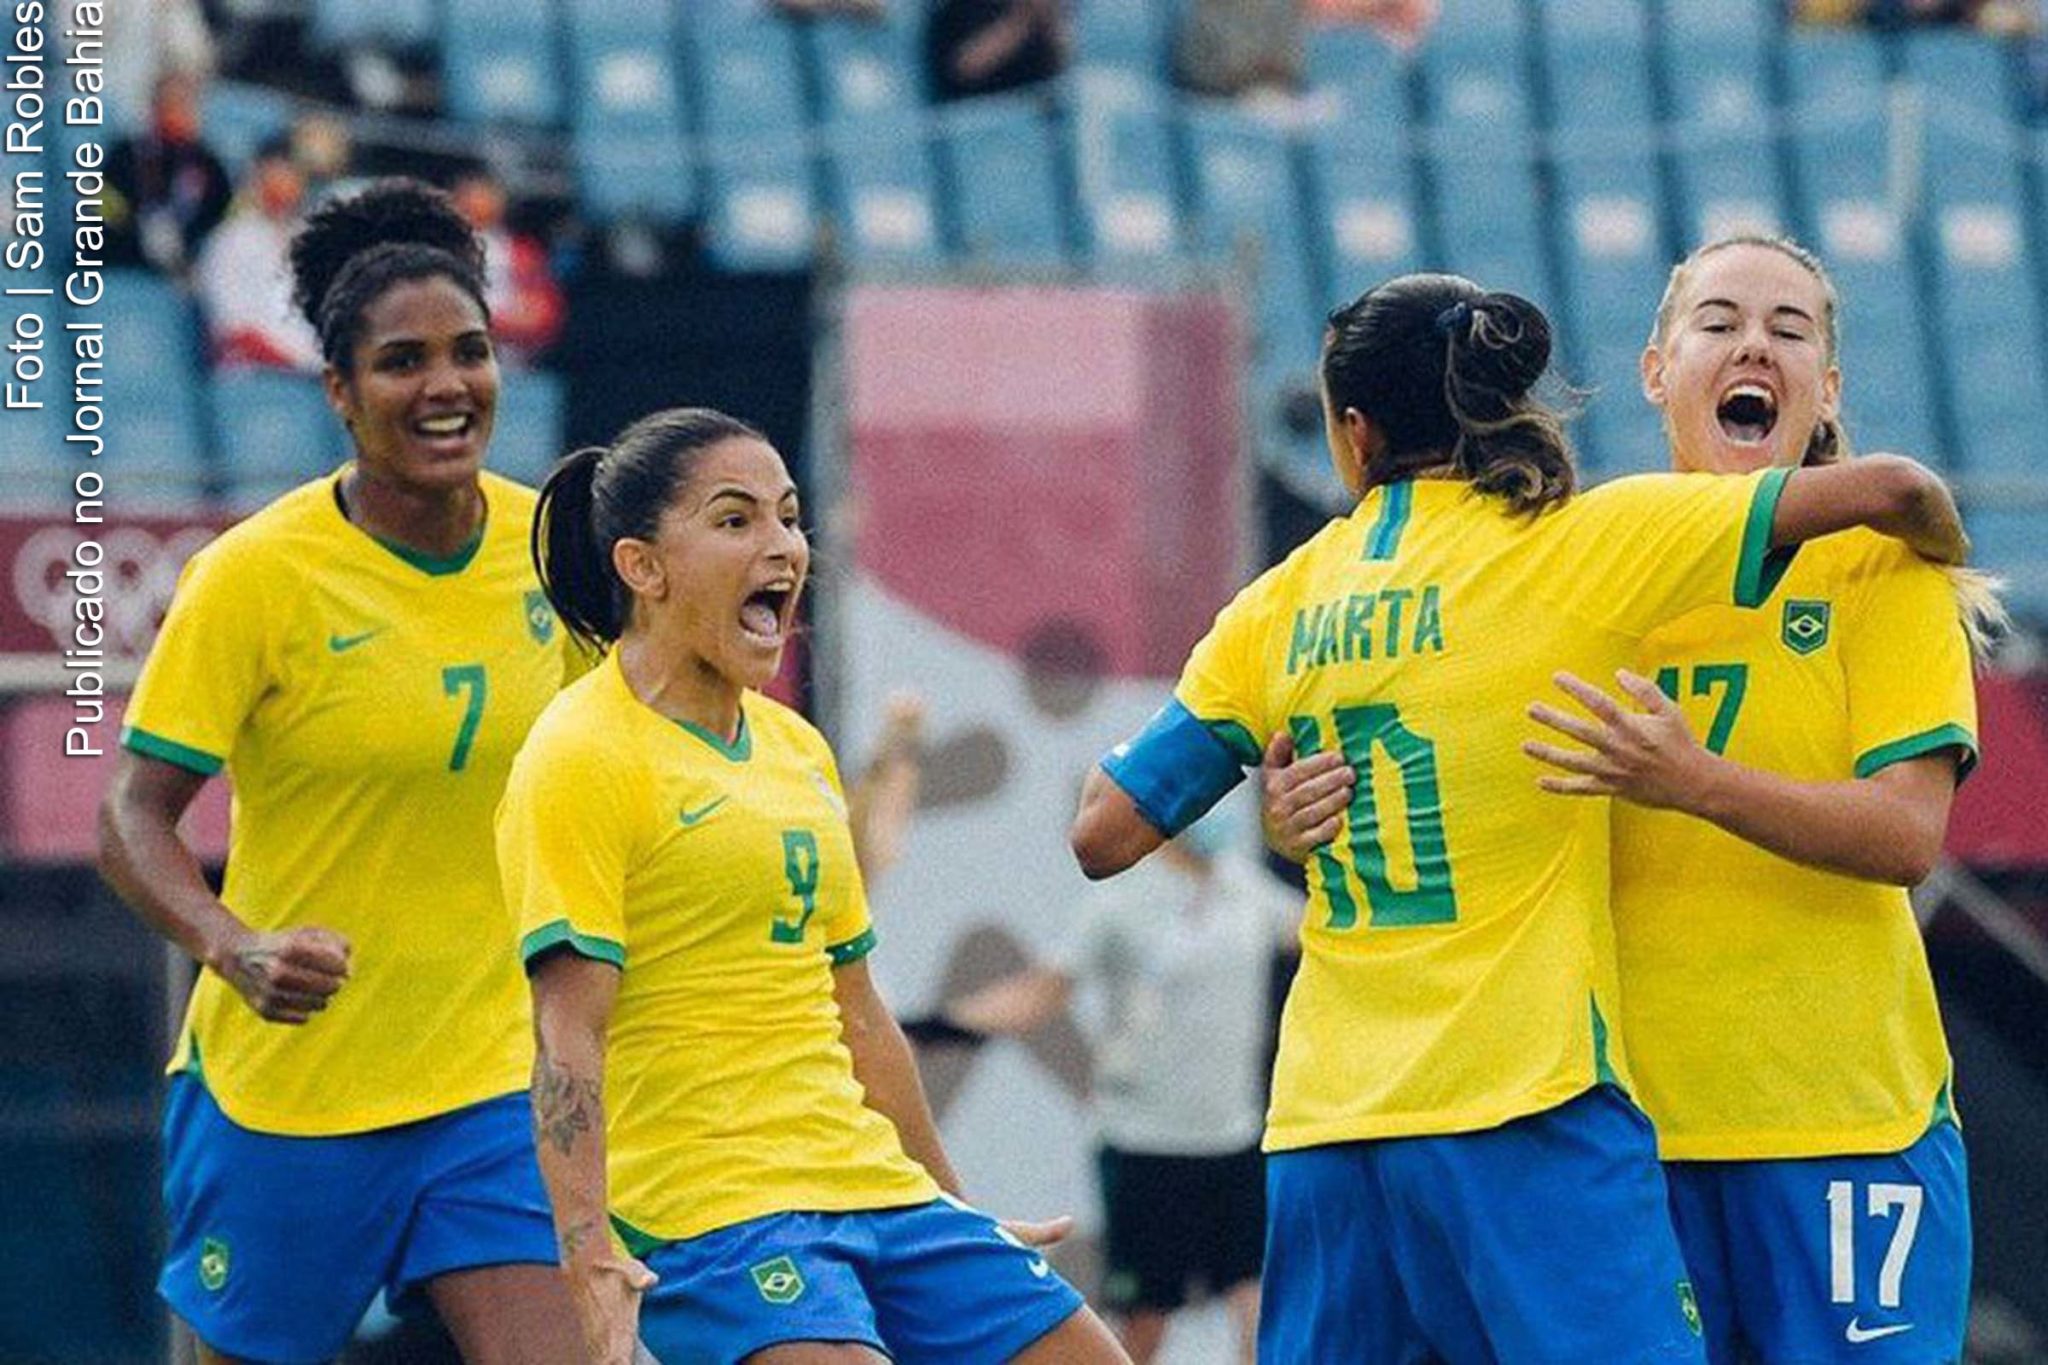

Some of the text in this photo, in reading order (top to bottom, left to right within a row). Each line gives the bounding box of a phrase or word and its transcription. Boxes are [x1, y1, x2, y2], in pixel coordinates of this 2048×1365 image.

[1287, 585, 1444, 675] MARTA
[442, 665, 486, 771] 7
[1288, 702, 1458, 928] 10
[771, 830, 820, 942] 9
[1826, 1181, 1923, 1307] 17
